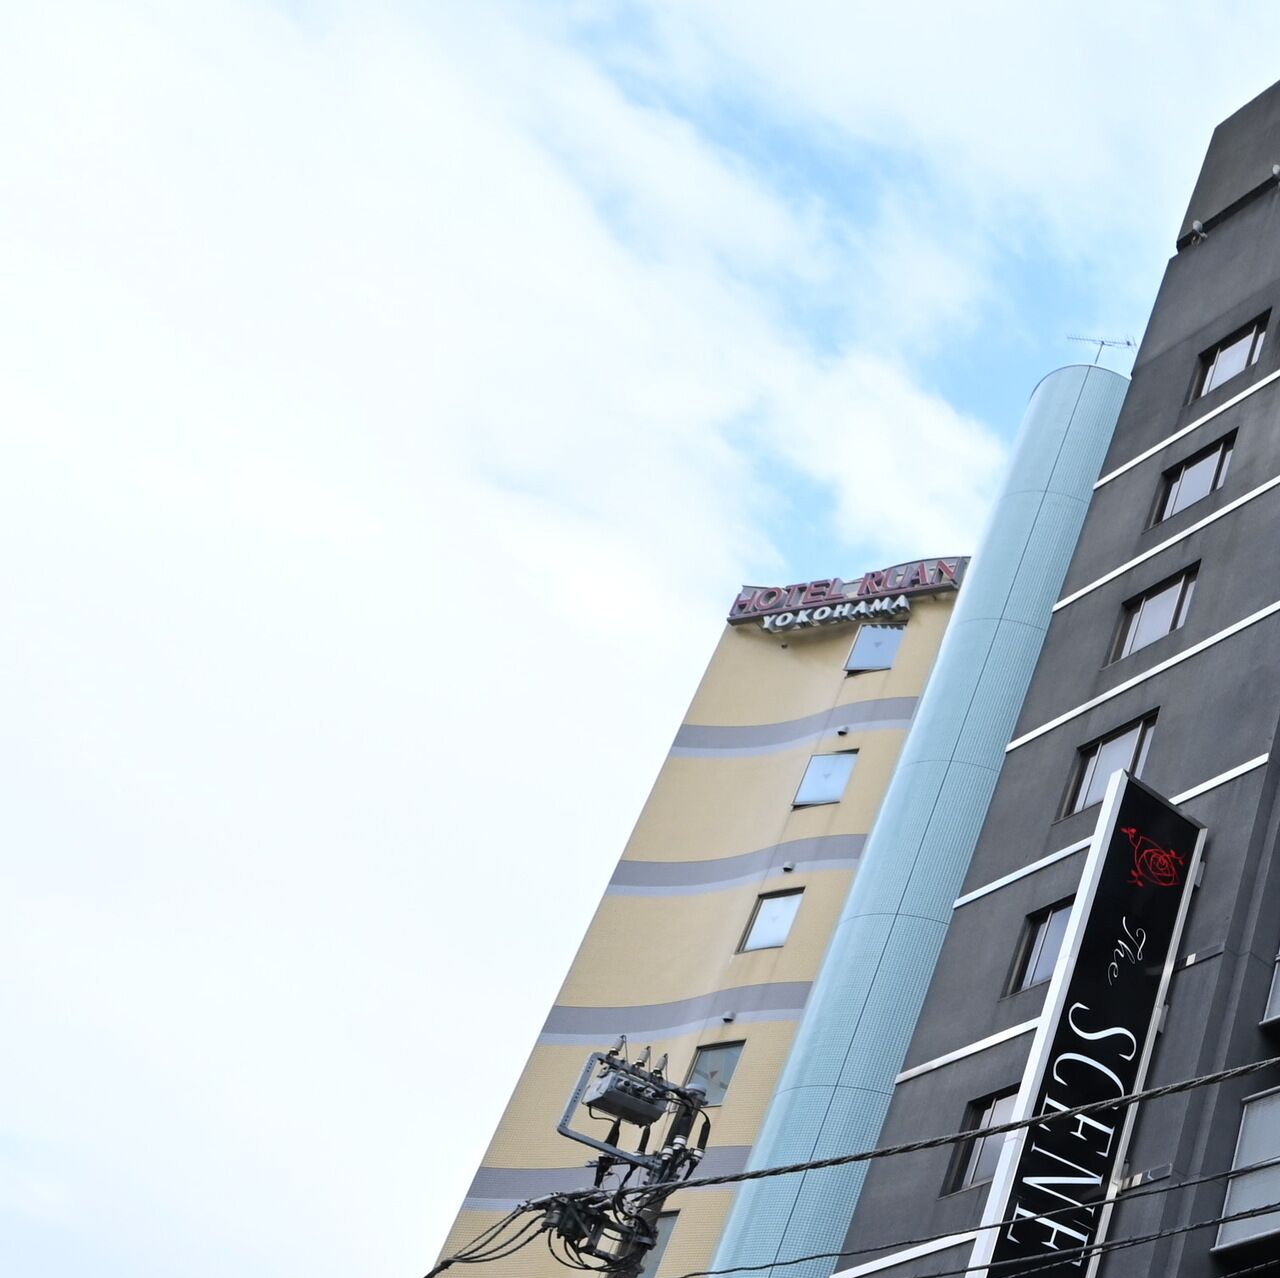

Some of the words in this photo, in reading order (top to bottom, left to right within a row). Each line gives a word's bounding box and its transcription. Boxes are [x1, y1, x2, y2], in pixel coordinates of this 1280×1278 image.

[729, 578, 844, 616] HOTEL
[857, 558, 964, 596] RUAN
[763, 595, 908, 629] YOKOHAMA
[1107, 916, 1146, 986] The
[1007, 1002, 1136, 1266] SCENE
